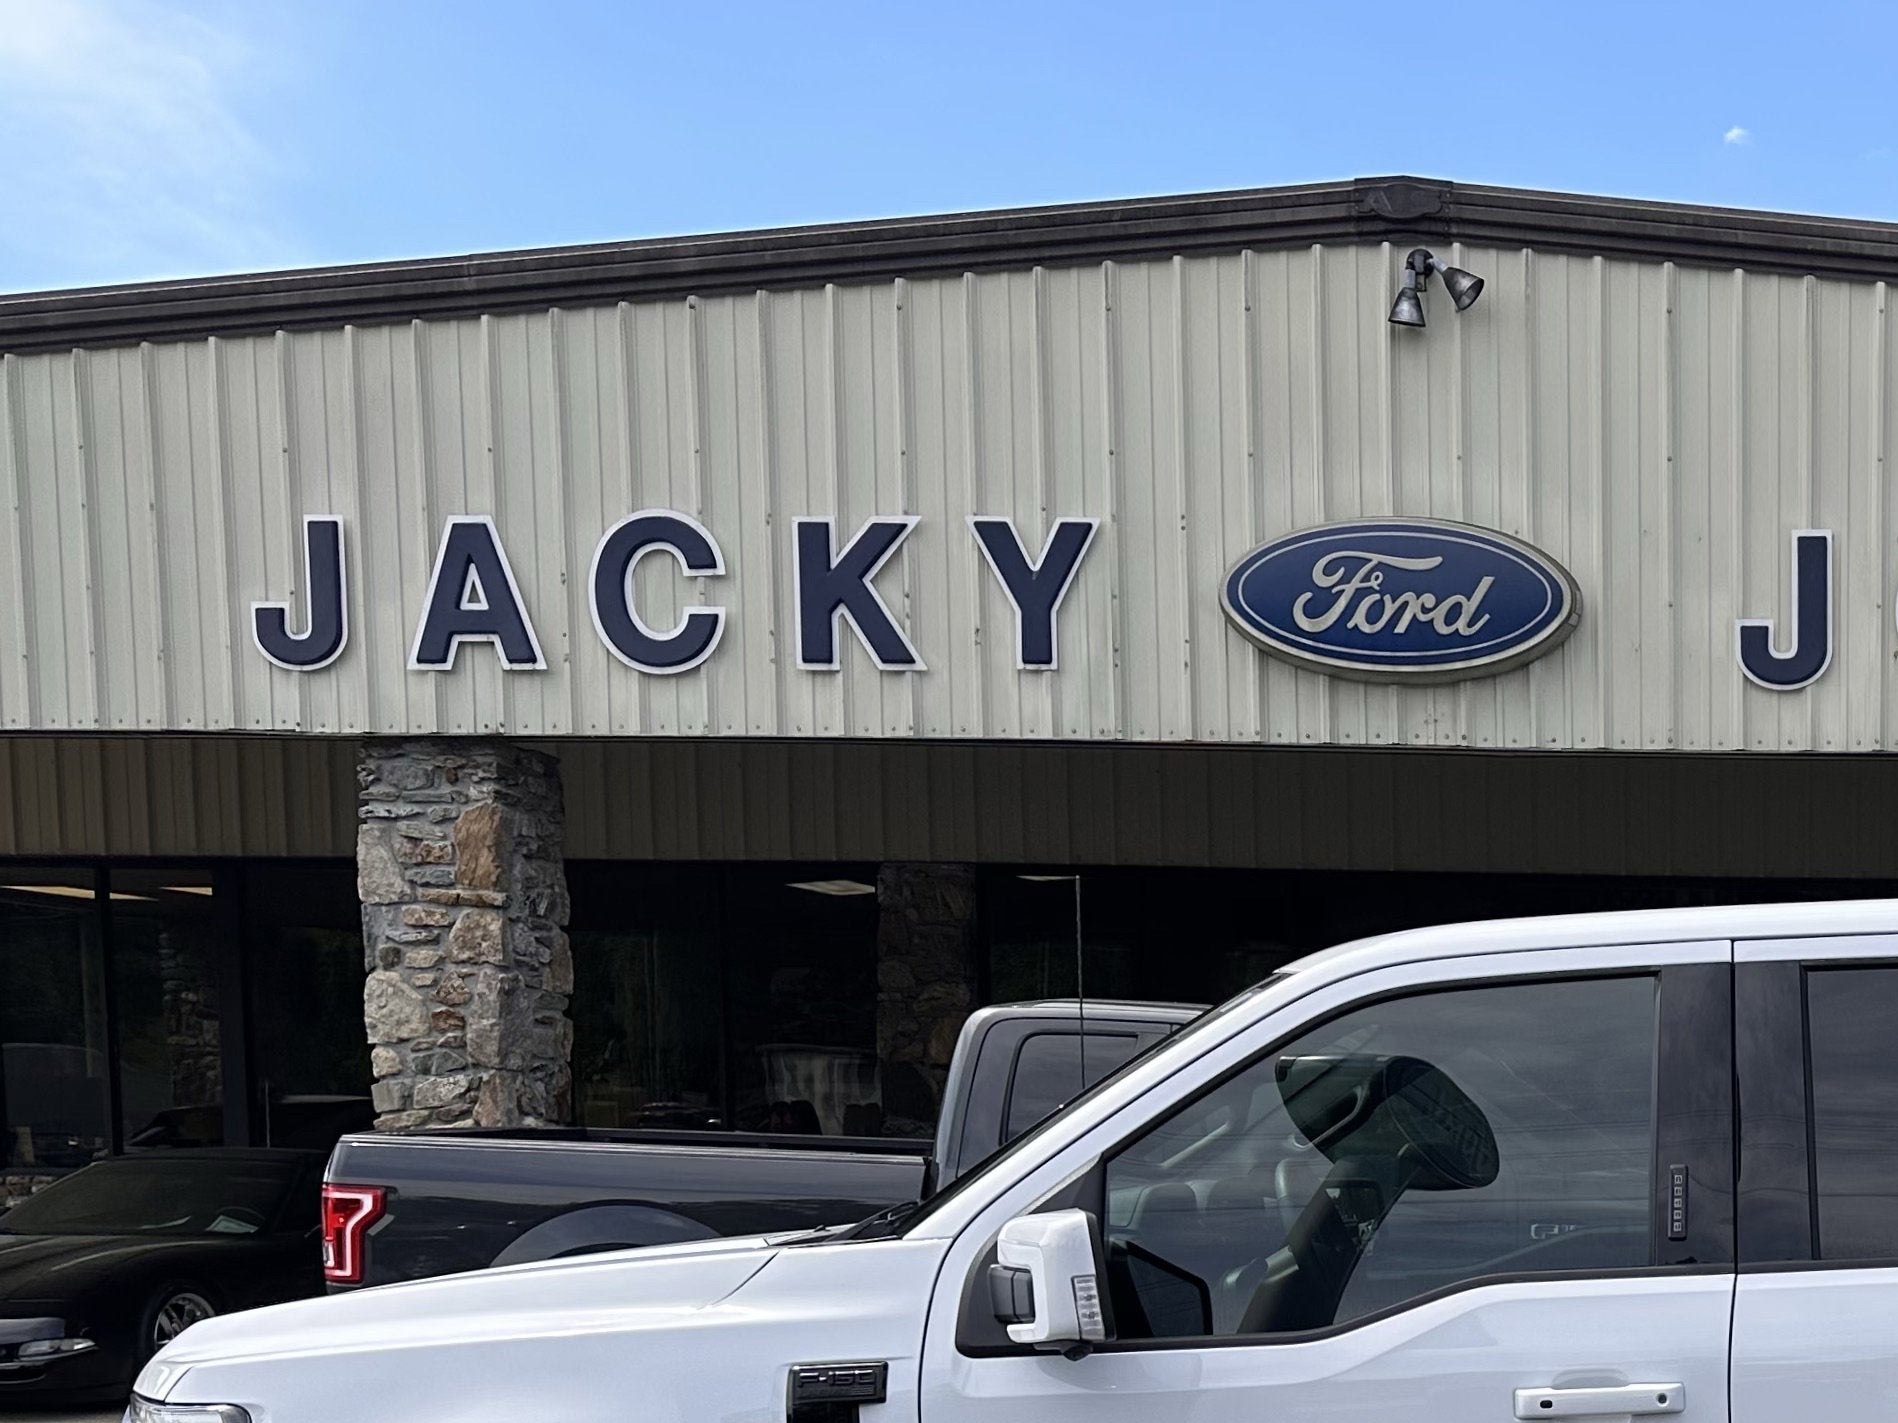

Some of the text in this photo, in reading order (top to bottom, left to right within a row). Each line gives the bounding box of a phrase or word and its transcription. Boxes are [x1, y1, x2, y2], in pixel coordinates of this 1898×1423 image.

[251, 508, 1101, 676] JACKY
[1291, 548, 1500, 642] Ford
[797, 1369, 875, 1387] F-150
